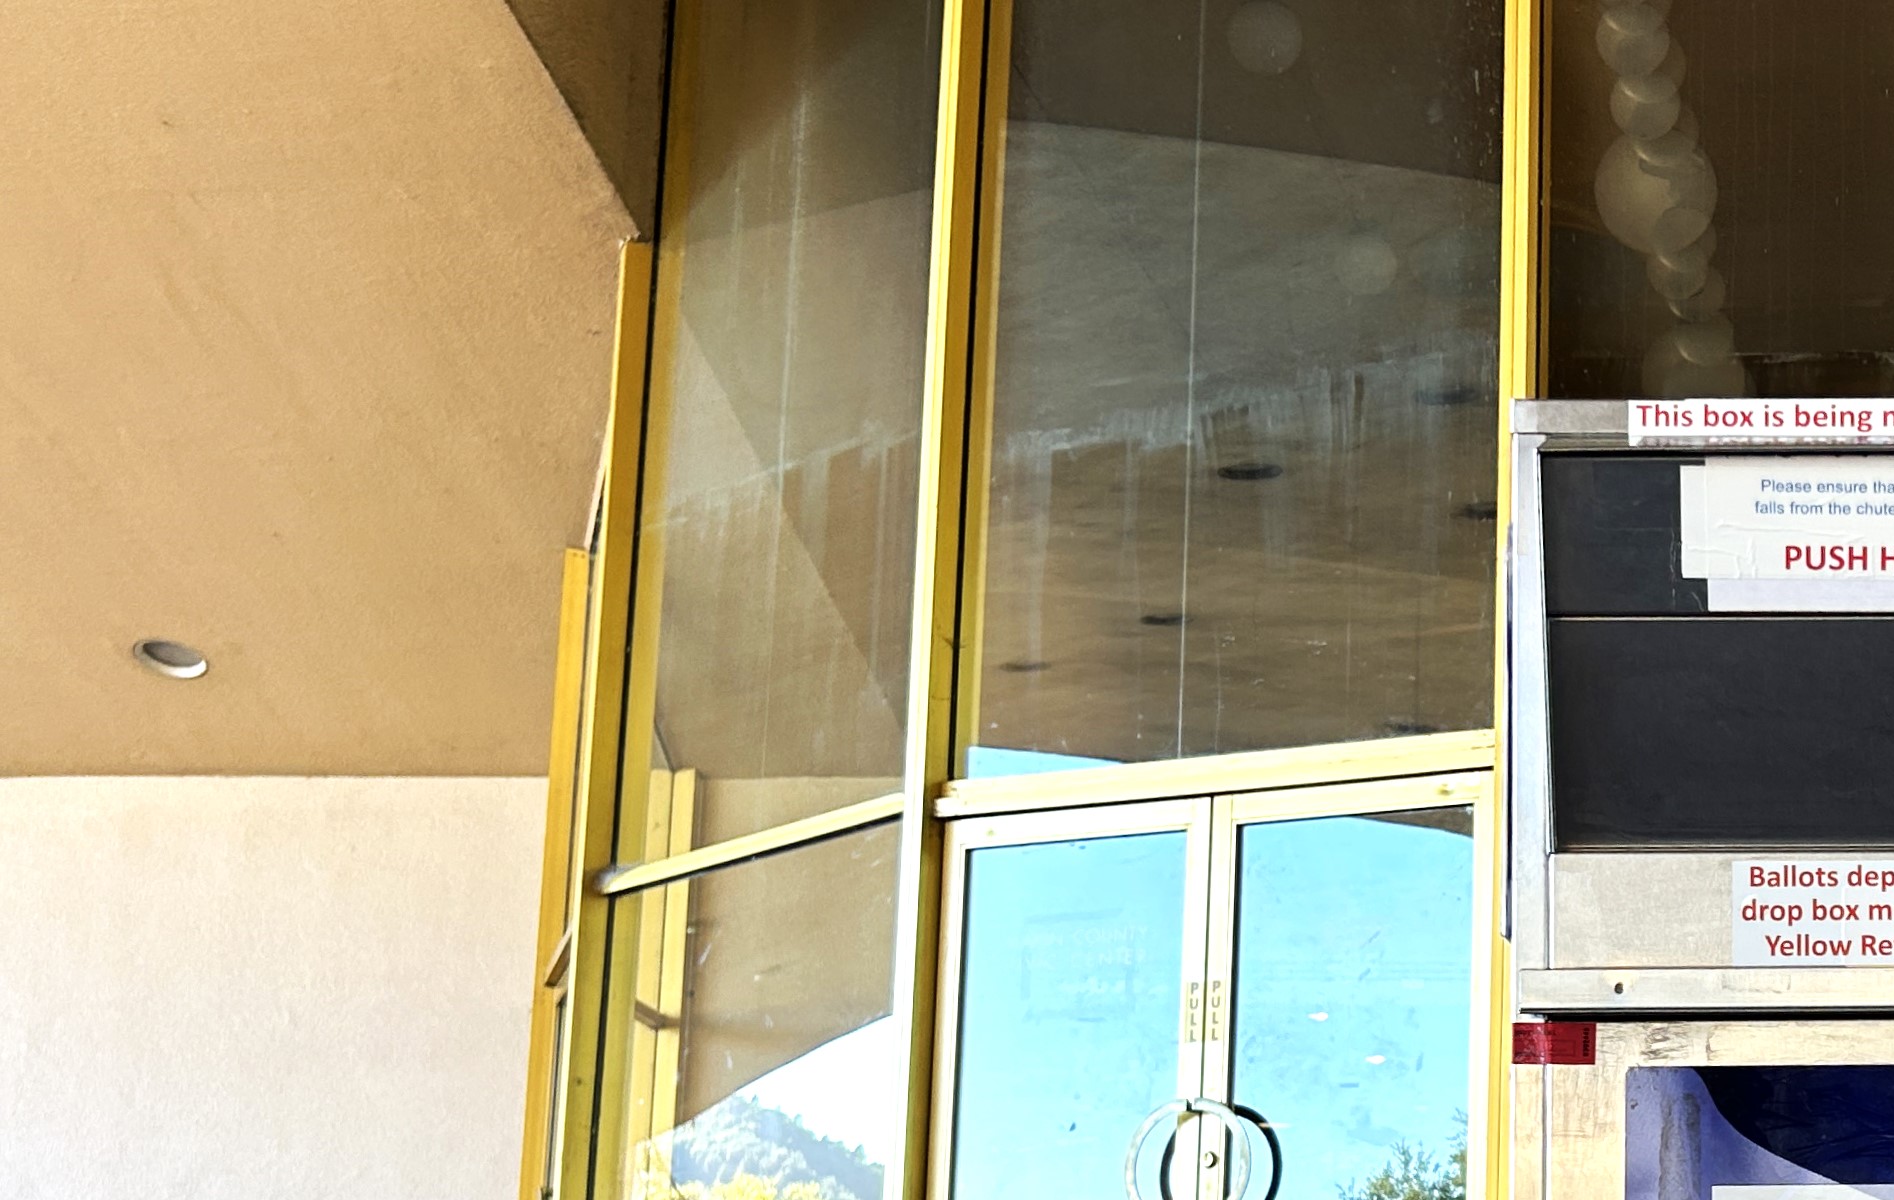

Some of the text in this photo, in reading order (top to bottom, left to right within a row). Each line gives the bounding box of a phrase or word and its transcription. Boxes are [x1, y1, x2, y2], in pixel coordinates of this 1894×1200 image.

[1636, 404, 1693, 428] This
[1703, 404, 1753, 428] box
[1764, 405, 1784, 428] is
[1794, 403, 1873, 433] being
[1760, 479, 1812, 493] Please
[1816, 481, 1868, 494] ensure
[1754, 501, 1785, 515] falls
[1789, 501, 1823, 515] from
[1828, 501, 1851, 515] the
[1784, 545, 1869, 572] PUSH
[1748, 865, 1839, 888] Ballots
[1741, 898, 1803, 926] drop
[1812, 898, 1860, 921] box
[1764, 933, 1852, 957] Yellow
[1189, 981, 1200, 1043] PULL
[1211, 980, 1222, 1042] PULL
